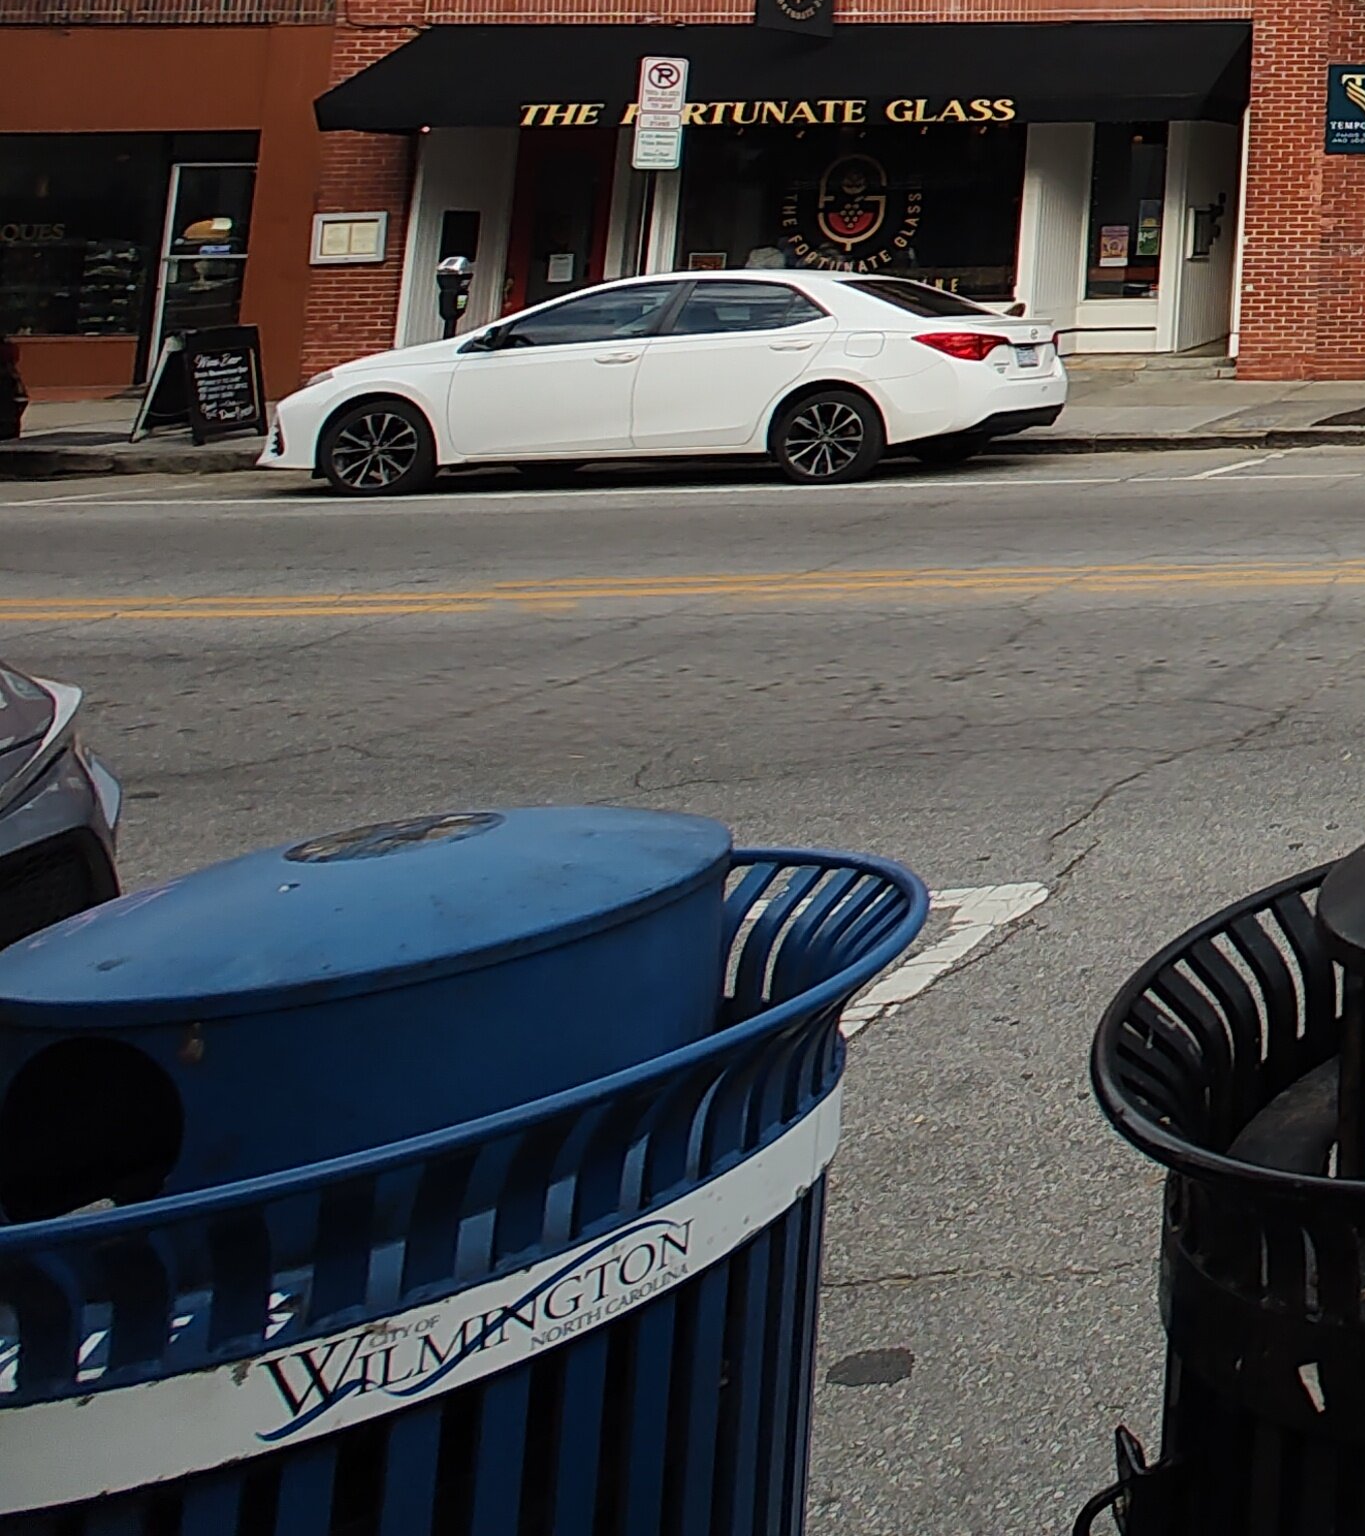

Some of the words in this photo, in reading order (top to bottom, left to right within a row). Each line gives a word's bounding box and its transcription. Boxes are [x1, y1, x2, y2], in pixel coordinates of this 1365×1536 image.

[519, 103, 605, 127] THE
[619, 99, 867, 127] FRTUNATE
[884, 97, 1017, 124] GLASS
[257, 1217, 695, 1417] WILMINGTON
[368, 1321, 414, 1350] CITY
[415, 1313, 441, 1336] OF
[529, 1307, 602, 1352] NORTH
[603, 1263, 690, 1314] CAROLINA
